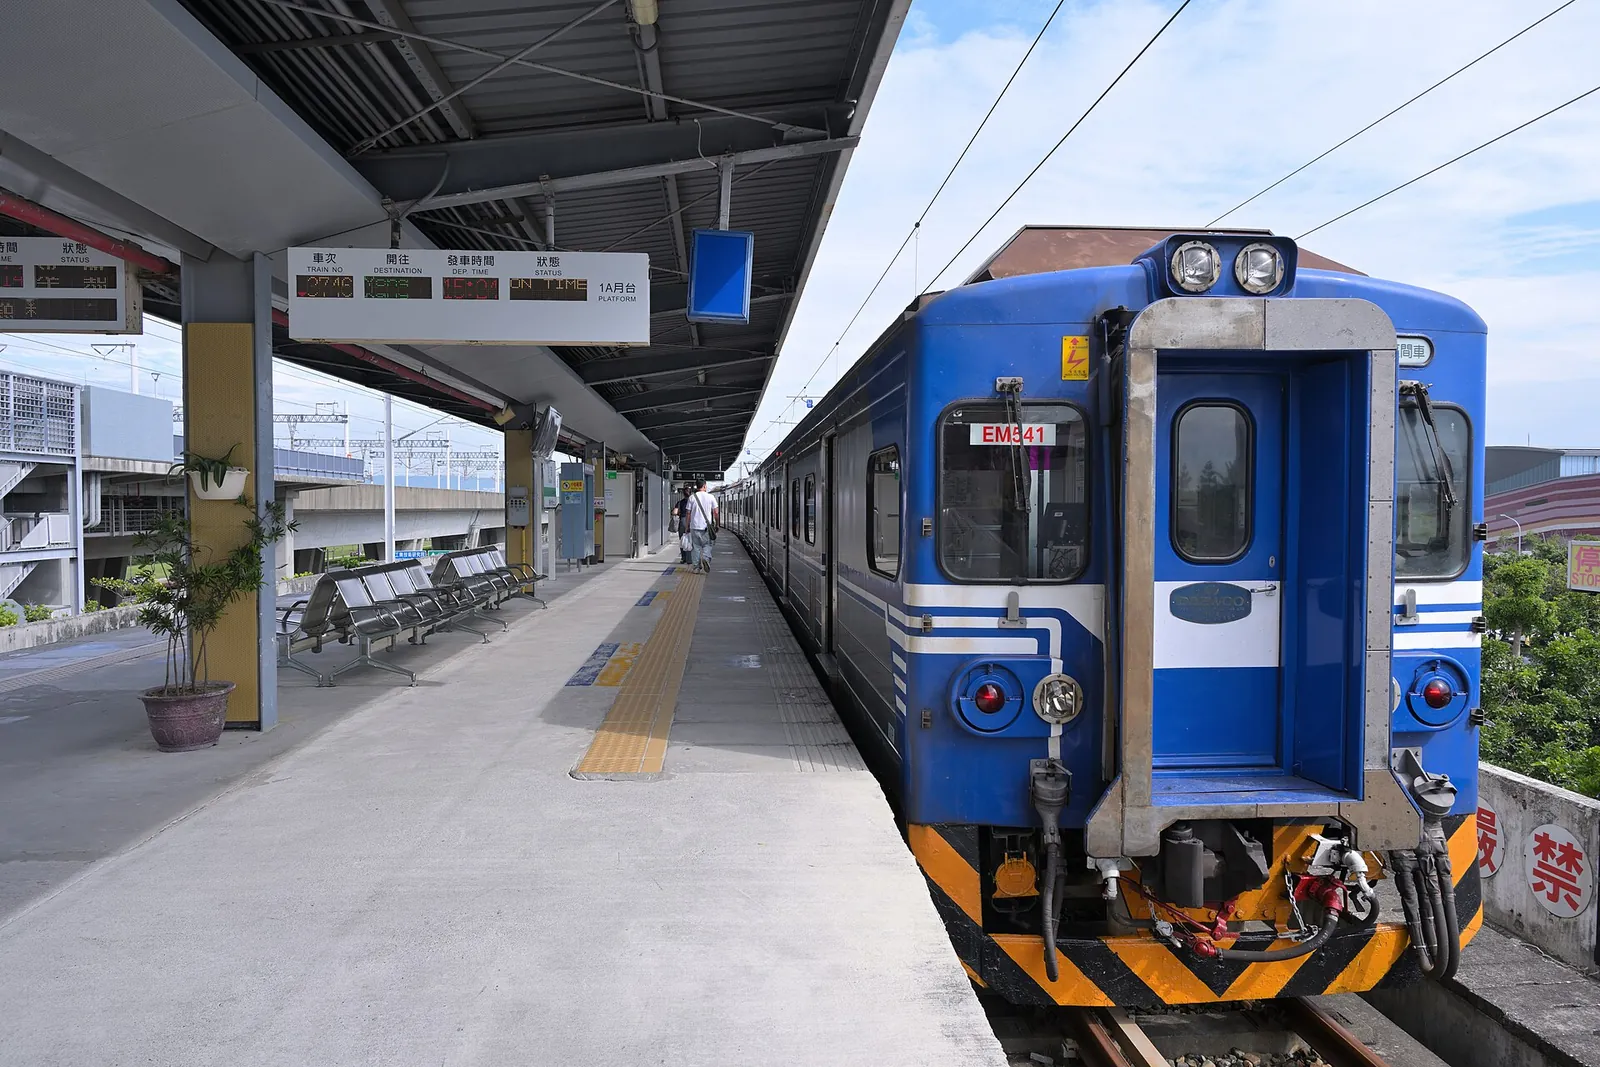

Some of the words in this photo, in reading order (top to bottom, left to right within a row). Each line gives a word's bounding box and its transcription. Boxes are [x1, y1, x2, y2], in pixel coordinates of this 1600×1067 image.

[62, 242, 88, 254] 狀態
[60, 256, 90, 264] STATUS
[312, 252, 337, 264] 車次
[386, 253, 410, 265] 開往
[447, 254, 495, 267] 發車時間
[536, 255, 561, 268] 狀態
[373, 266, 423, 274] DESTINATION
[470, 268, 489, 276] TIME
[534, 269, 563, 277] STATUS
[510, 278, 532, 290] ON
[543, 278, 588, 291] TIME
[598, 282, 637, 294] 1A月台
[597, 295, 637, 303] PLATFORM
[1397, 343, 1425, 359] 間車
[982, 425, 1044, 443] EM541
[1574, 546, 1600, 573] 停
[1531, 831, 1584, 912] 禁
